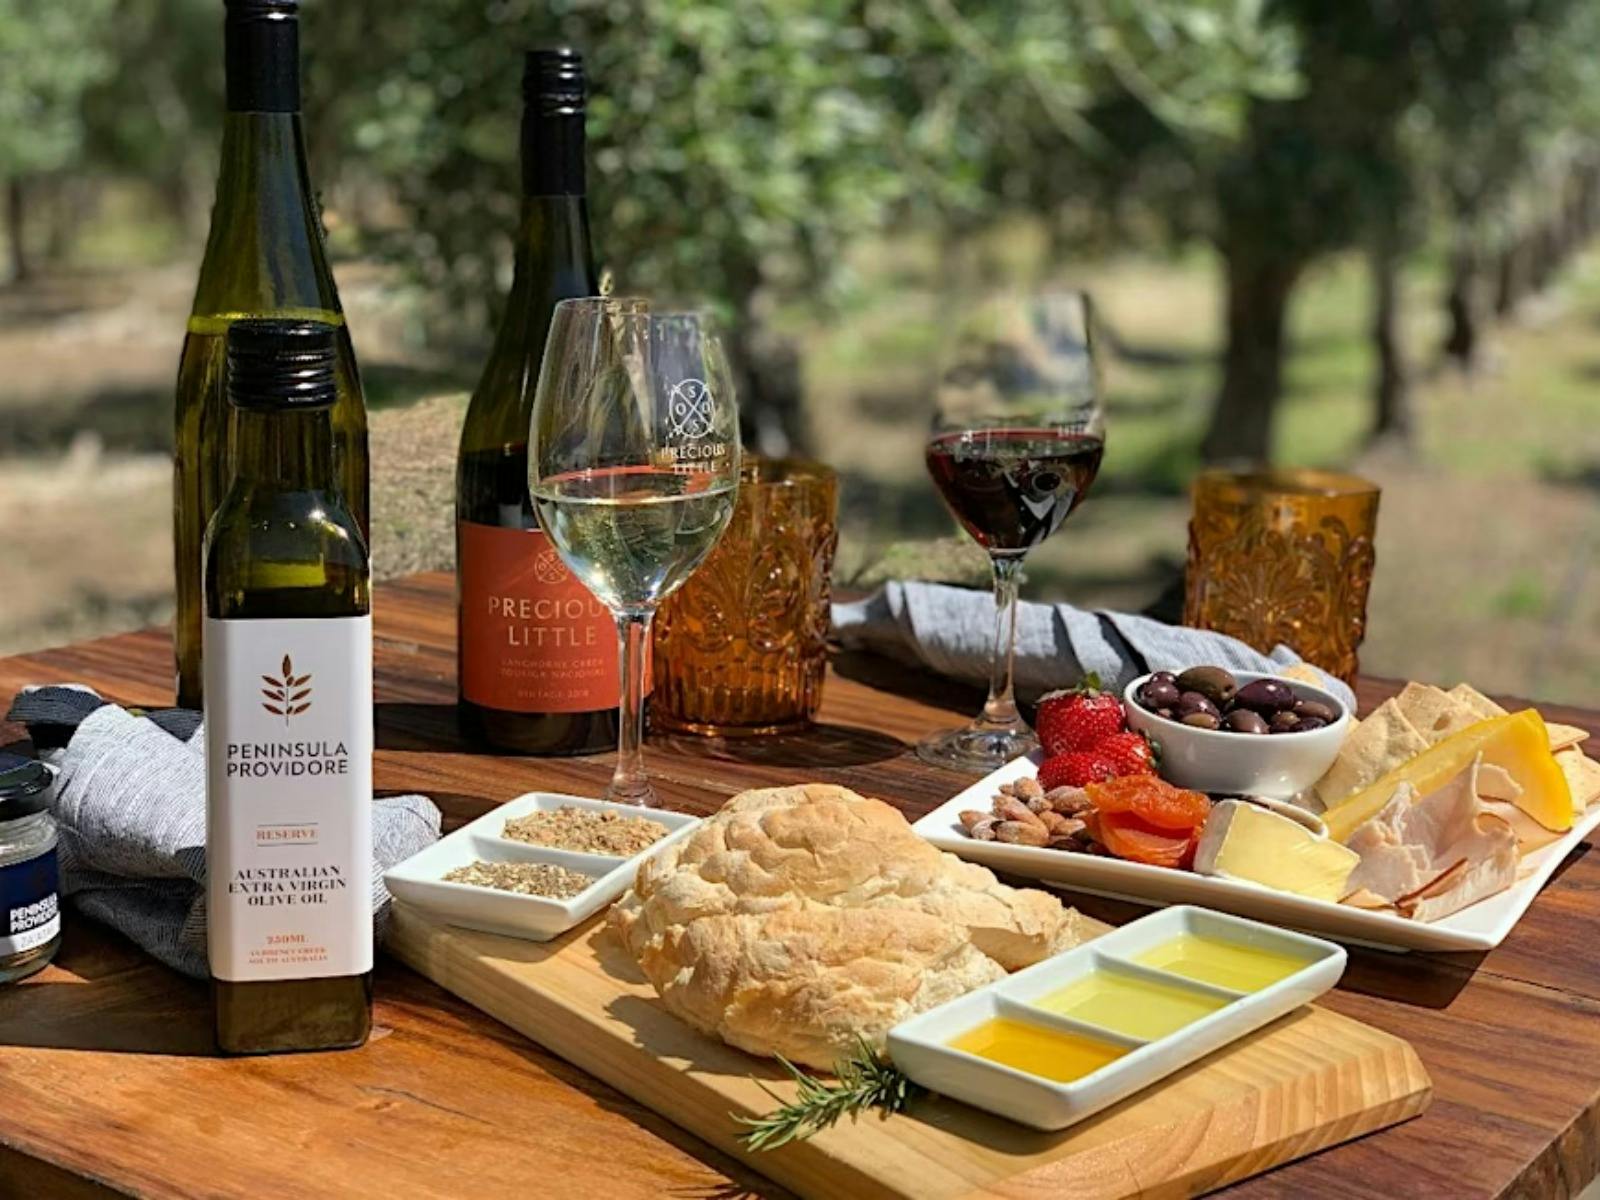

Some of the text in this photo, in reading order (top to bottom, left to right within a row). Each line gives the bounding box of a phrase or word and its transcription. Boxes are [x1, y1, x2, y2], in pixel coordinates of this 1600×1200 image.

[488, 595, 604, 620] PRECIOU
[508, 625, 597, 647] LITTLE
[227, 741, 348, 759] PENINSULA
[227, 759, 348, 777] PROVIDORE
[256, 830, 318, 840] RESERVE
[235, 865, 341, 880] AUSTRALIAN
[229, 879, 346, 893] EXTRA VIRGIN
[248, 893, 328, 906] OLIVE OIL
[266, 934, 310, 944] 250ML
